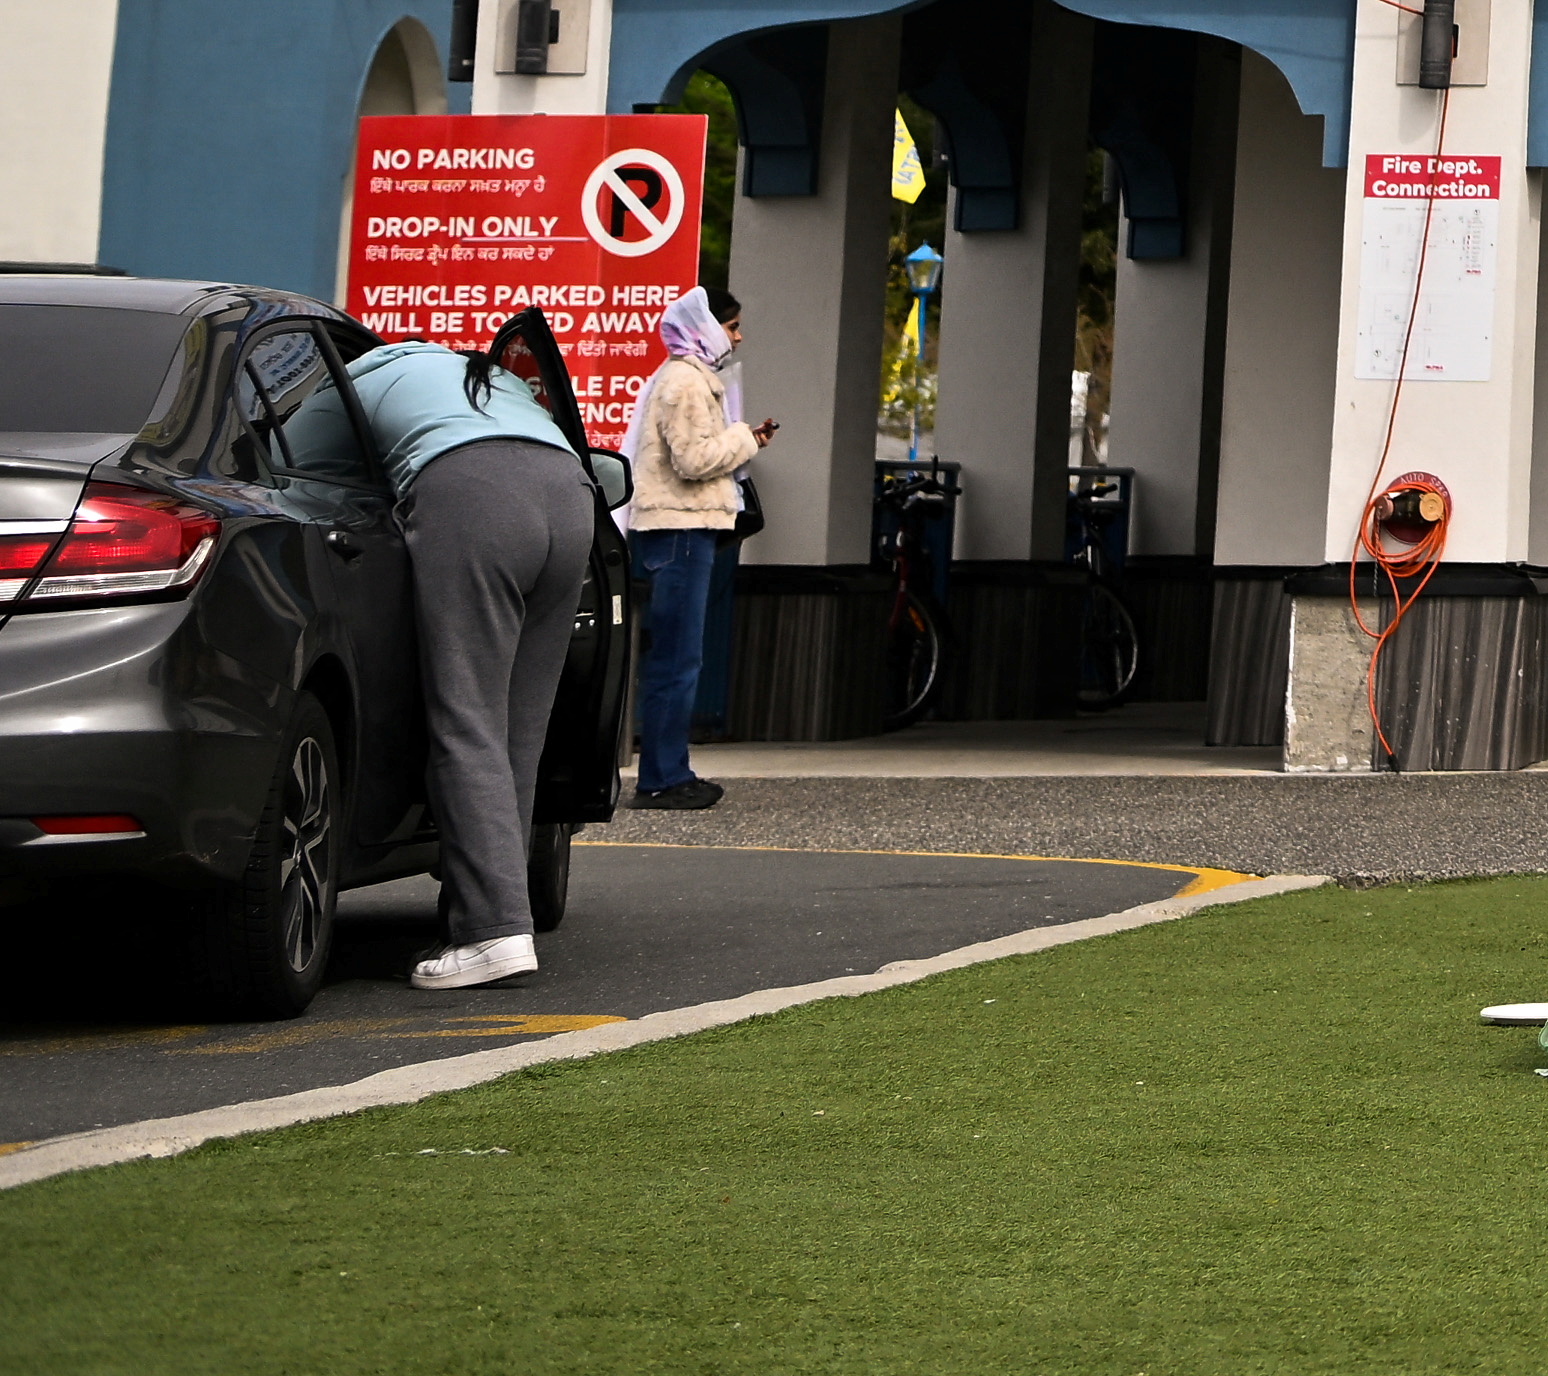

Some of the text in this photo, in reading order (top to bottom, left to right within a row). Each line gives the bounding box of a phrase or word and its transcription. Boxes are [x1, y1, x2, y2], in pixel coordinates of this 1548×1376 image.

[371, 148, 535, 170] NO PARKING
[1382, 156, 1483, 175] Fire Dept.
[366, 215, 559, 238] DROP-IN ONLY
[363, 285, 680, 307] VEHICLES PARKED HERE
[361, 311, 662, 334] WILL BE TOED AWAY
[609, 376, 648, 398] FO
